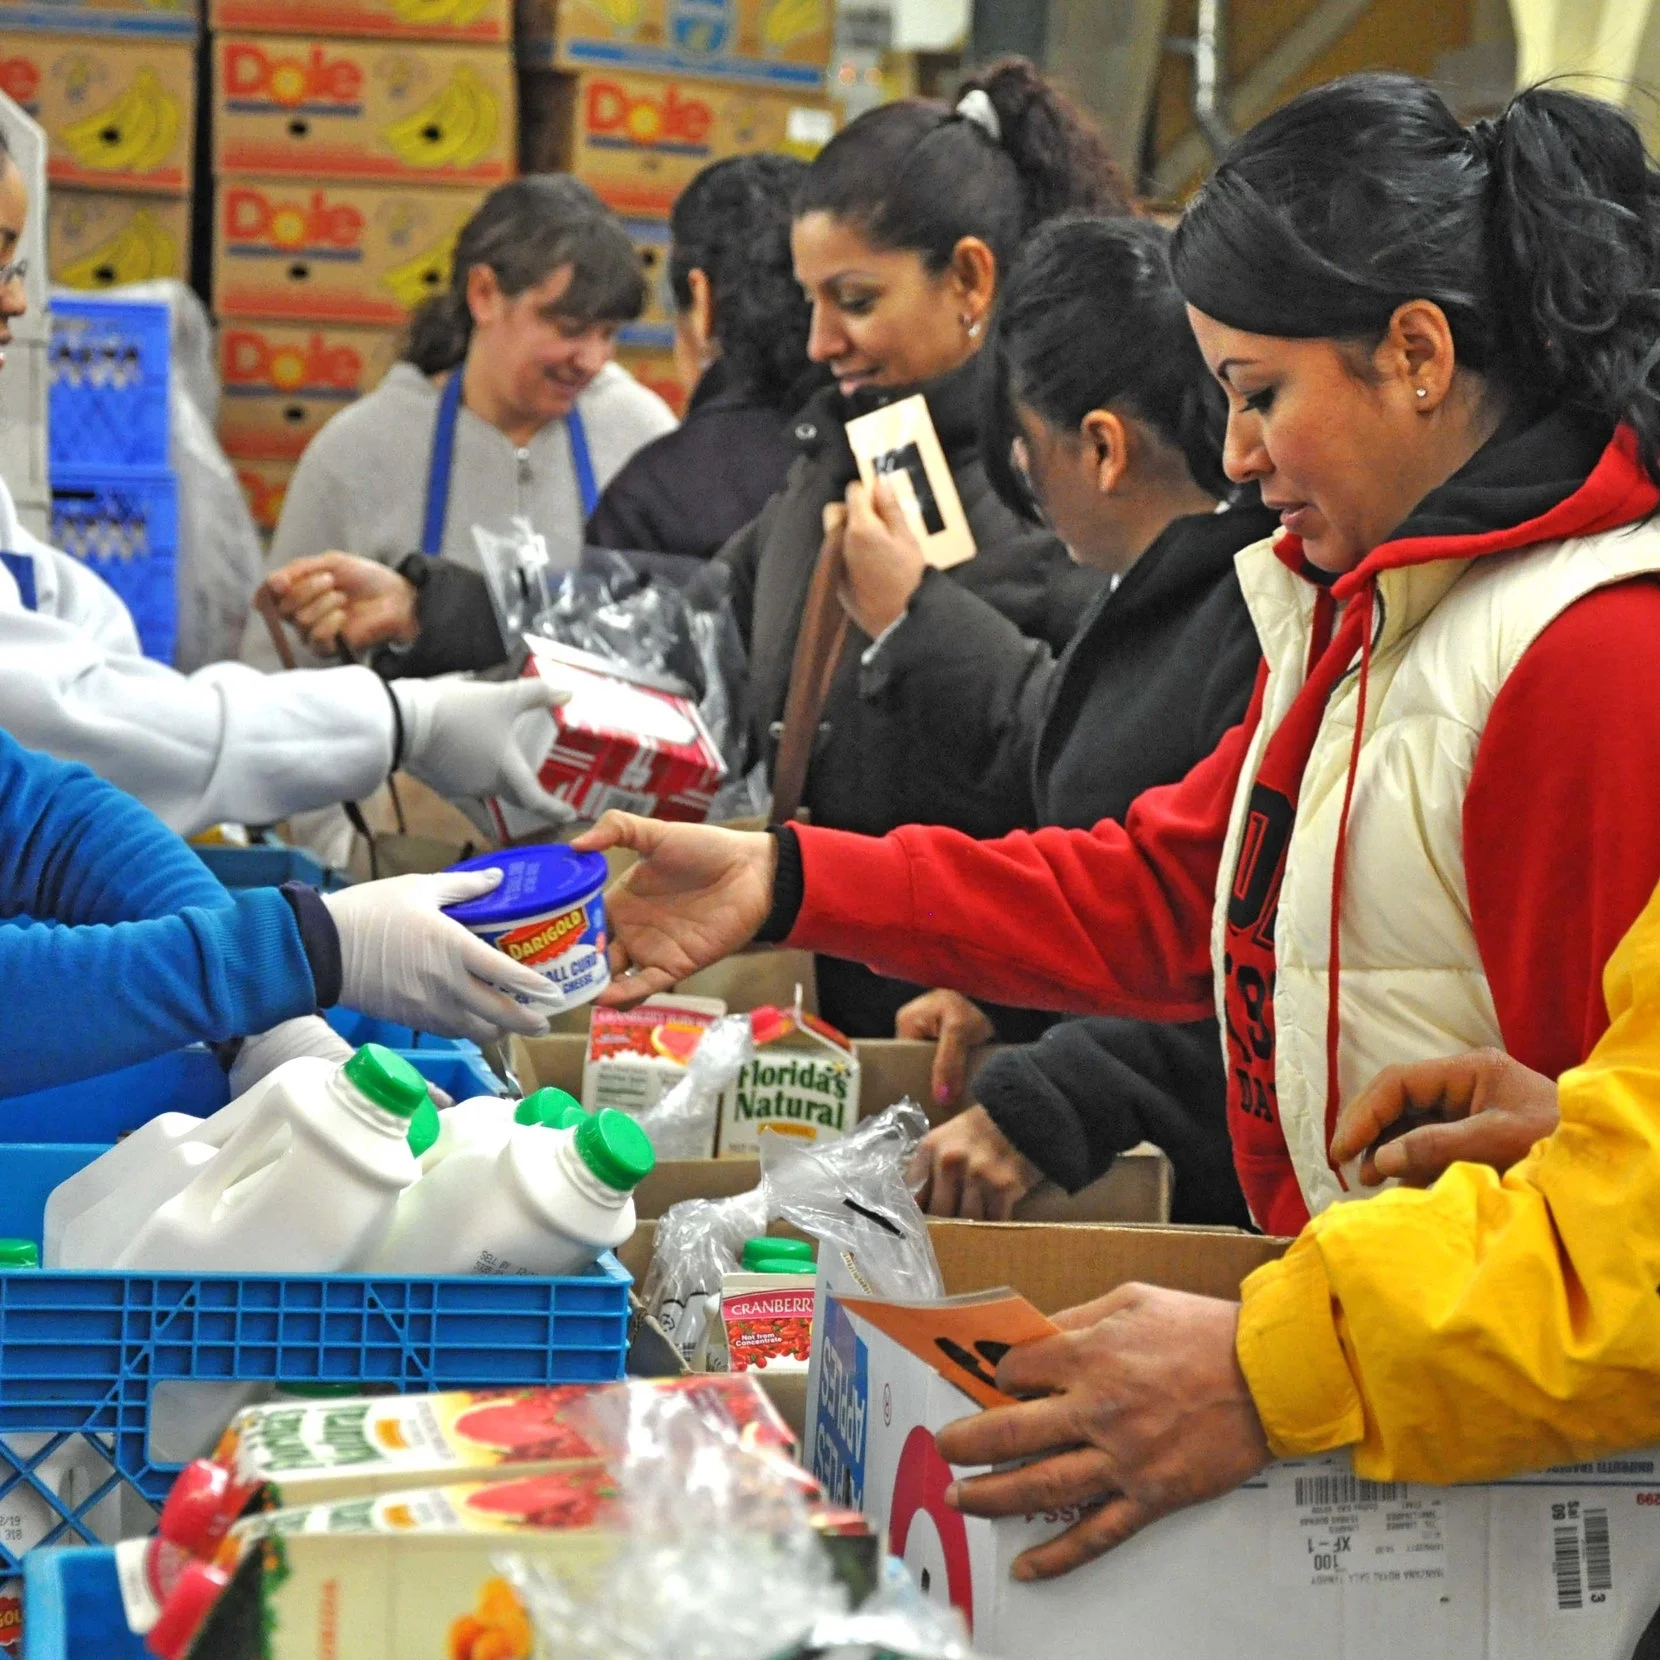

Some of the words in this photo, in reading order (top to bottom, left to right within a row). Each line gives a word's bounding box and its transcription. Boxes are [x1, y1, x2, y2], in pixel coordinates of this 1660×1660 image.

[223, 42, 364, 106] Dole
[586, 78, 712, 144] Dole
[223, 187, 364, 250] Dole
[223, 329, 363, 392] Dole
[508, 911, 583, 961] DARIGOLD
[541, 966, 569, 983] ALL
[737, 1060, 848, 1099] Florida's
[734, 1091, 845, 1132] Natural
[735, 1337, 783, 1347] Concentrate
[757, 1333, 775, 1341] from
[821, 1335, 866, 1464] APPLES
[815, 1422, 861, 1512] APLES
[1313, 1554, 1339, 1571] 100
